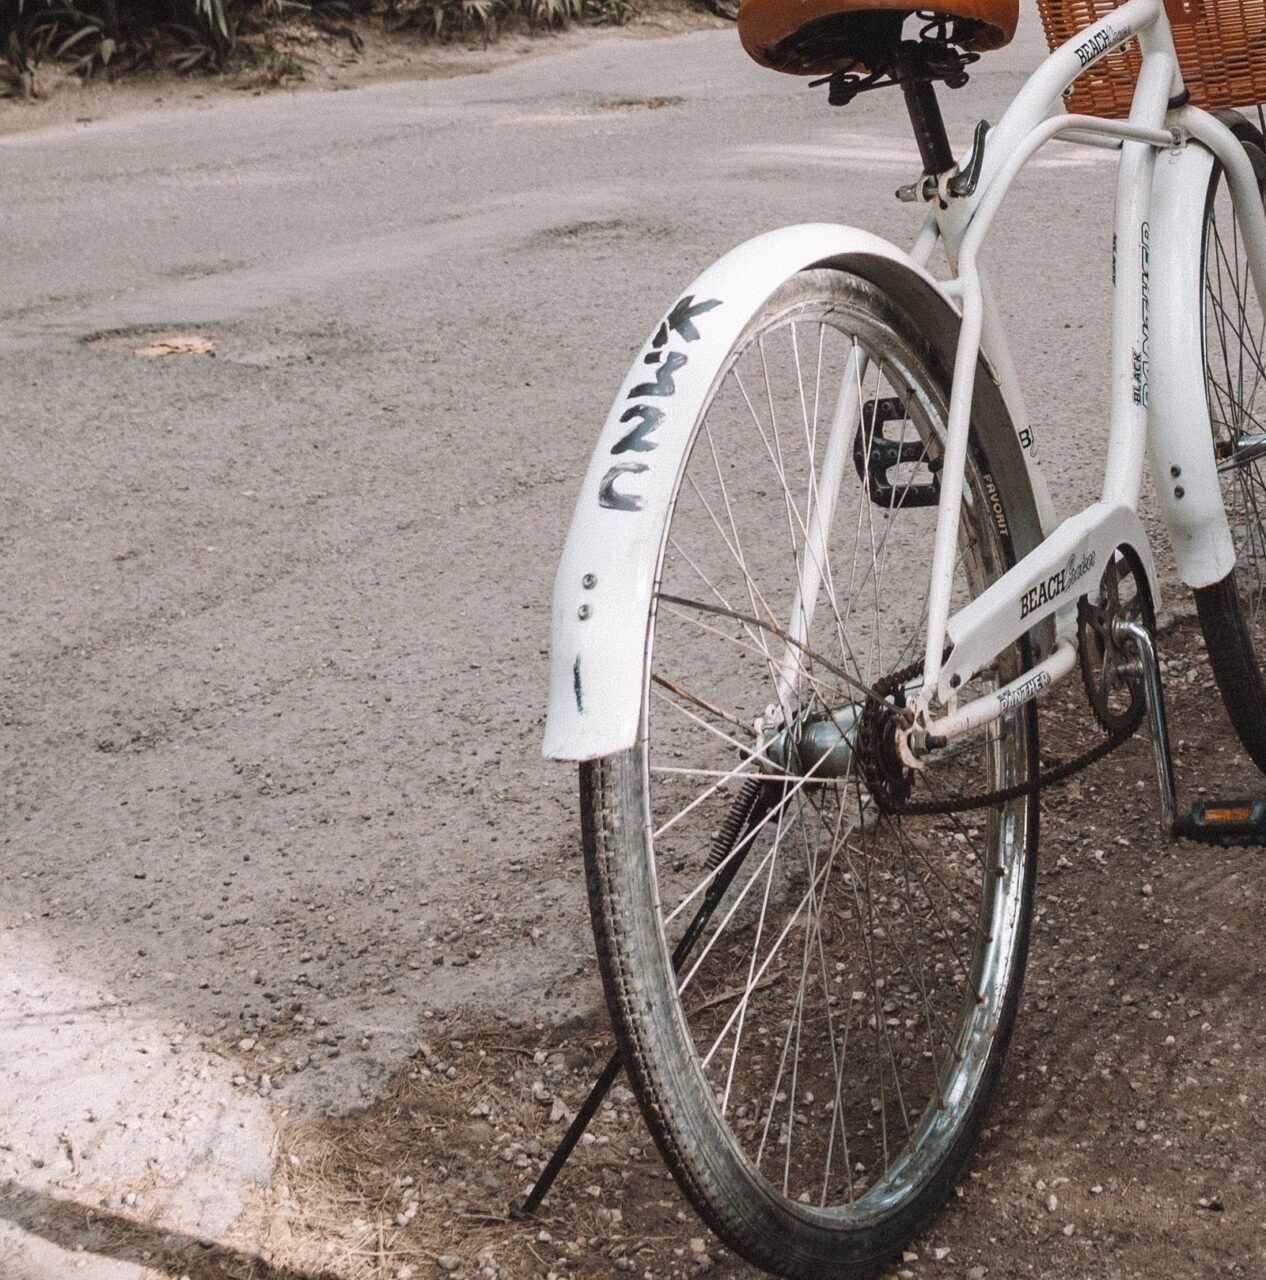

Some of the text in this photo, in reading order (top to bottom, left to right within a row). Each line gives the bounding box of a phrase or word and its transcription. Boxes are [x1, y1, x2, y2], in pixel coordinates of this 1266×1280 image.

[1074, 29, 1108, 67] BEACH
[1132, 351, 1142, 407] BLACK
[983, 474, 1008, 536] FAVORIT
[1020, 569, 1066, 619] BEACH
[999, 671, 1051, 711] PANTHER
